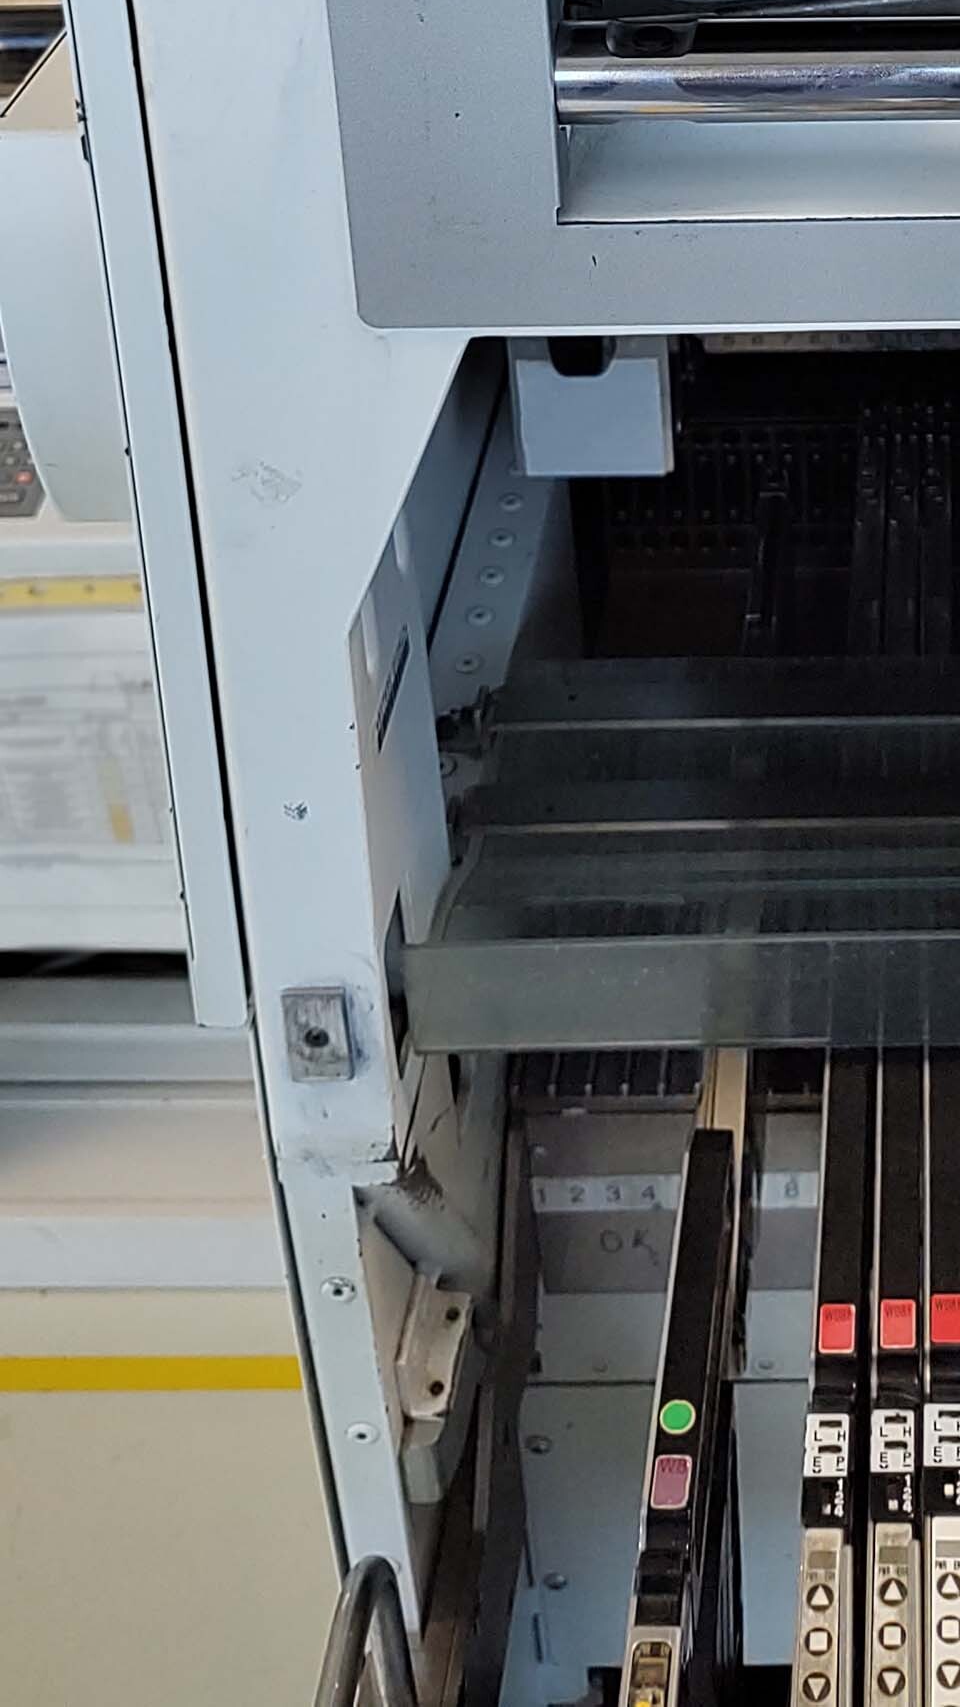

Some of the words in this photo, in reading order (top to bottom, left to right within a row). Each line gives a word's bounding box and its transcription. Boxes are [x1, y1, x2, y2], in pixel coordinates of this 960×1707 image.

[569, 1184, 586, 1204] 2
[605, 1183, 622, 1203] 3
[641, 1184, 656, 1201] 4
[880, 1426, 888, 1437] L
[903, 1426, 911, 1437] H
[934, 1421, 942, 1432] L
[814, 1431, 823, 1442] L
[837, 1431, 846, 1442] H
